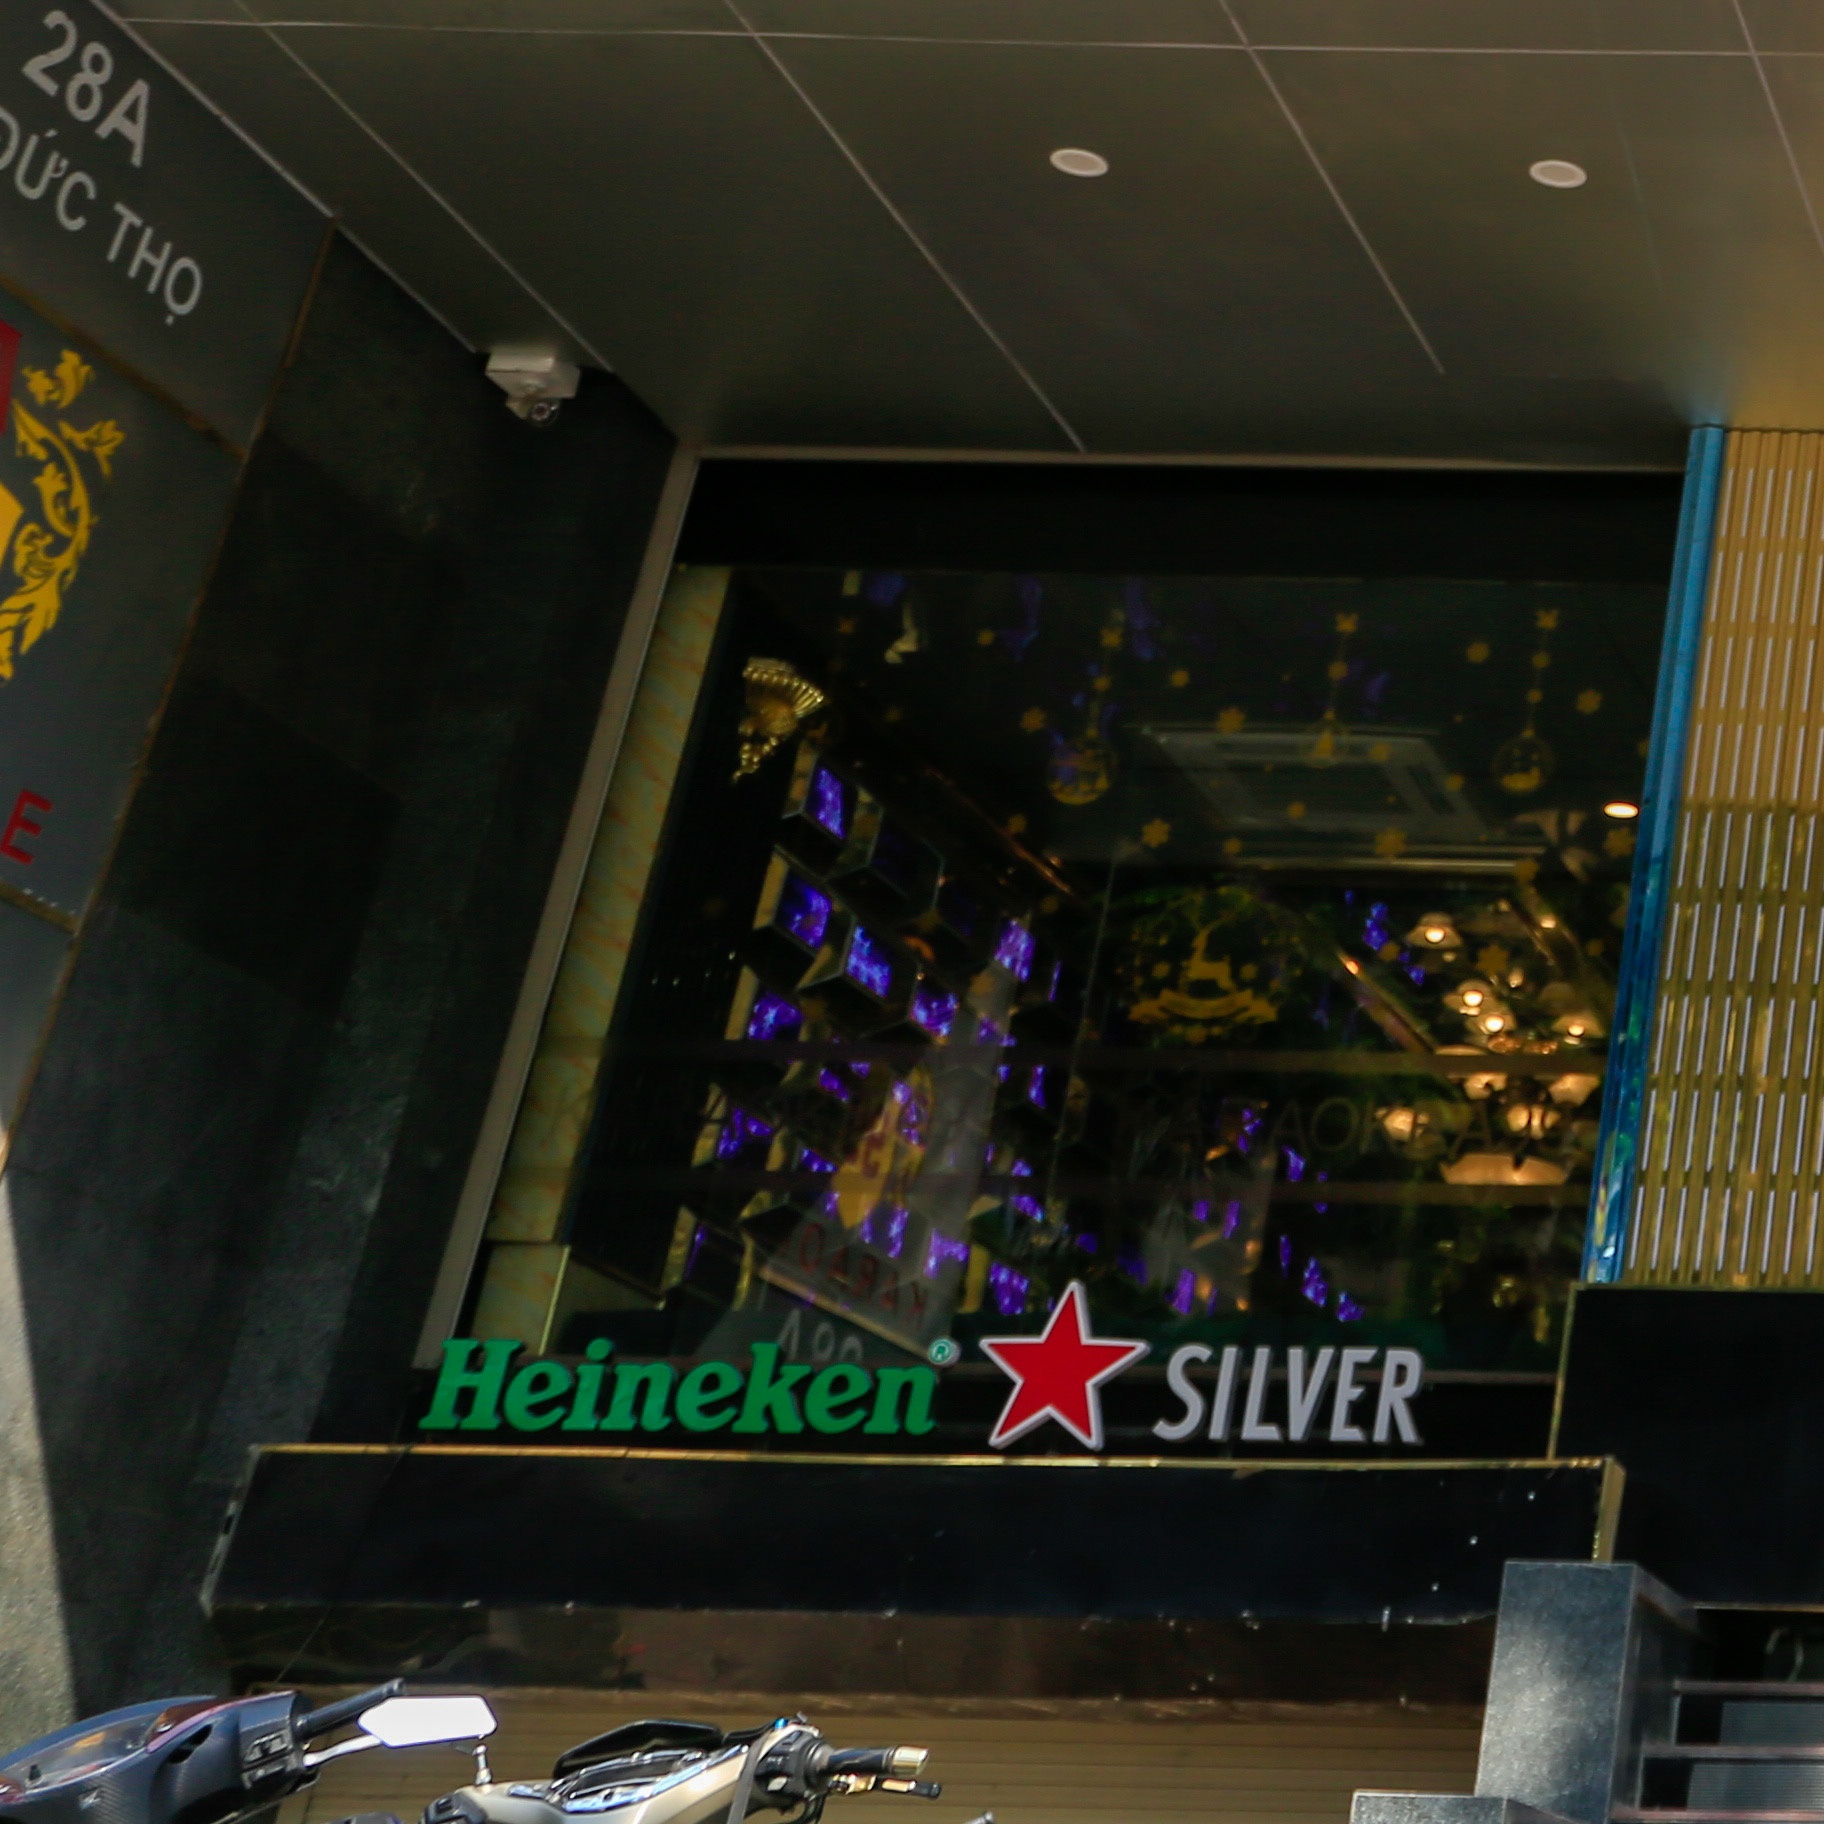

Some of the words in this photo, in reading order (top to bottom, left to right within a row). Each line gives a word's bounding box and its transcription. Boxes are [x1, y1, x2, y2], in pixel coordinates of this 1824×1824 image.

[21, 8, 150, 168] 28A
[105, 201, 203, 326] THỌ
[418, 1337, 936, 1435] Heineken
[1152, 1342, 1423, 1446] SILVER
